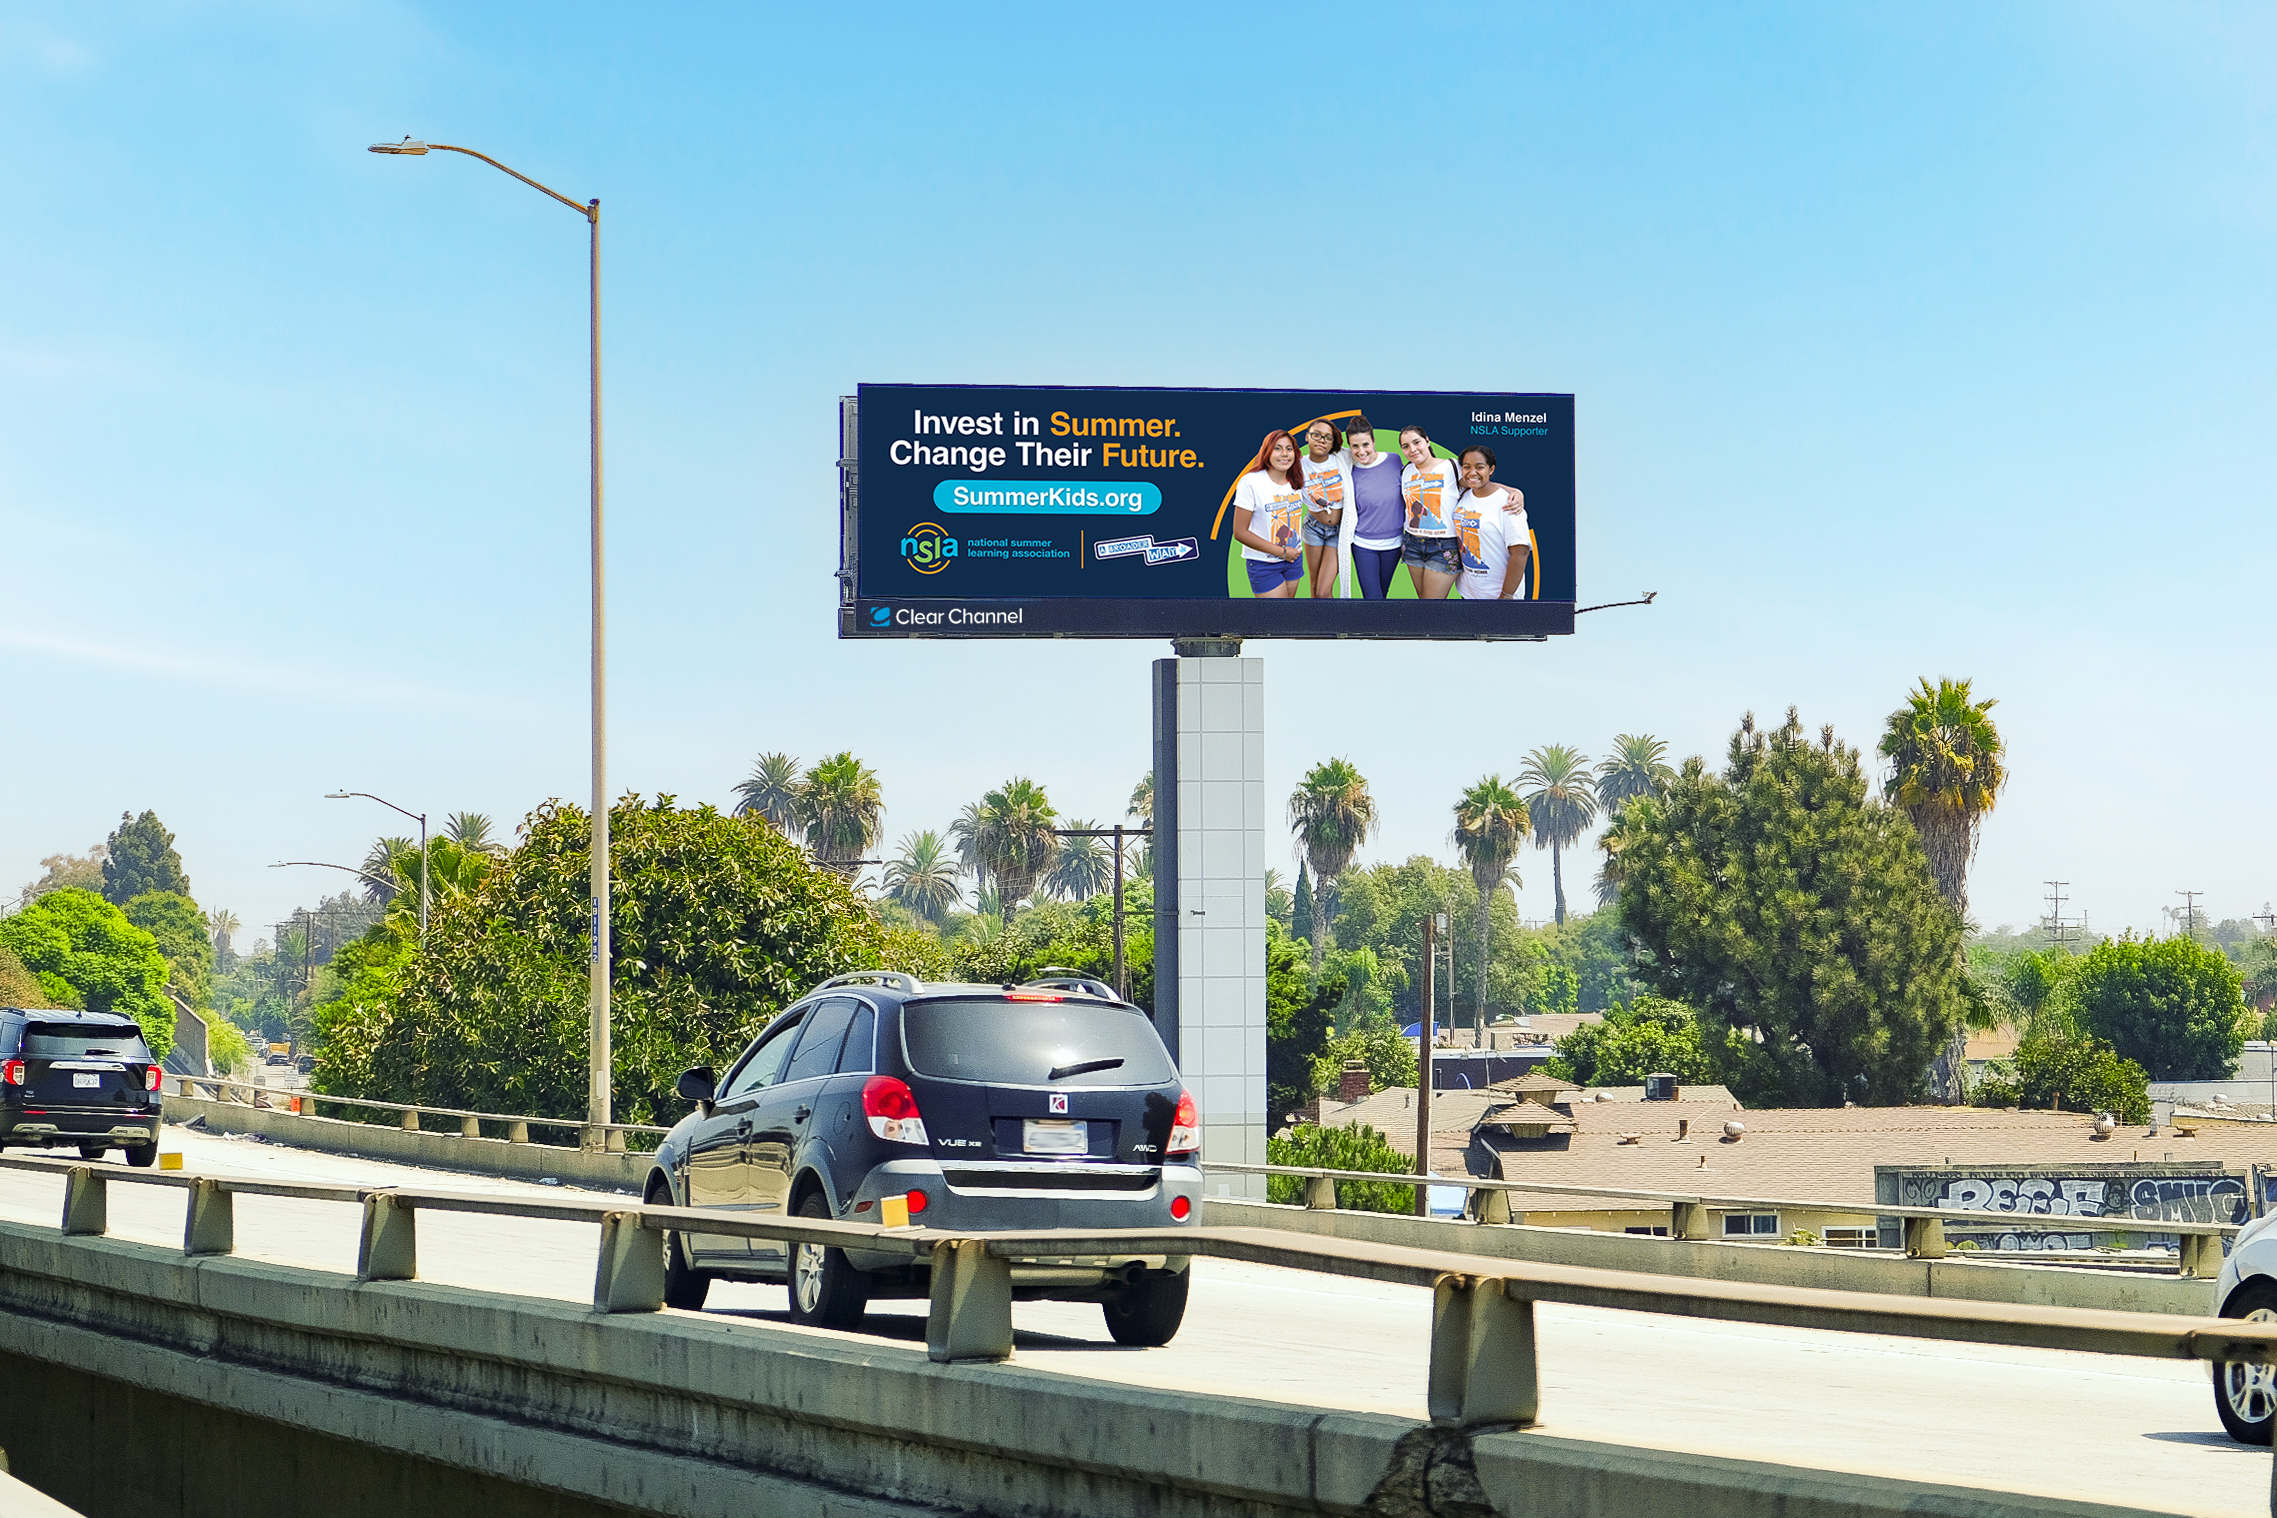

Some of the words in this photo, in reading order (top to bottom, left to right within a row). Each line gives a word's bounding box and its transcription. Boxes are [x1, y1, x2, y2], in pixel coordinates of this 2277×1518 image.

[914, 409, 1004, 436] Invest
[1013, 410, 1040, 436] in
[1050, 410, 1181, 438] Summer.
[1471, 411, 1502, 423] Idina
[1504, 411, 1547, 424] Menzel
[1470, 425, 1499, 436] NSLA
[1500, 425, 1549, 438] Supporter
[889, 439, 1007, 473] Change
[1014, 441, 1093, 467] Their
[1102, 442, 1205, 469] Future.
[953, 485, 1143, 513] SummerKids.org
[900, 533, 959, 565] nsla
[967, 537, 1009, 549] national
[1010, 539, 1053, 549] summer
[967, 548, 1009, 561] learning
[1011, 547, 1071, 559] association
[1148, 547, 1177, 561] WAY
[895, 608, 945, 626] Clear
[947, 607, 1023, 625] Channel
[937, 1138, 968, 1147] VUE
[1132, 1144, 1158, 1153] AWD
